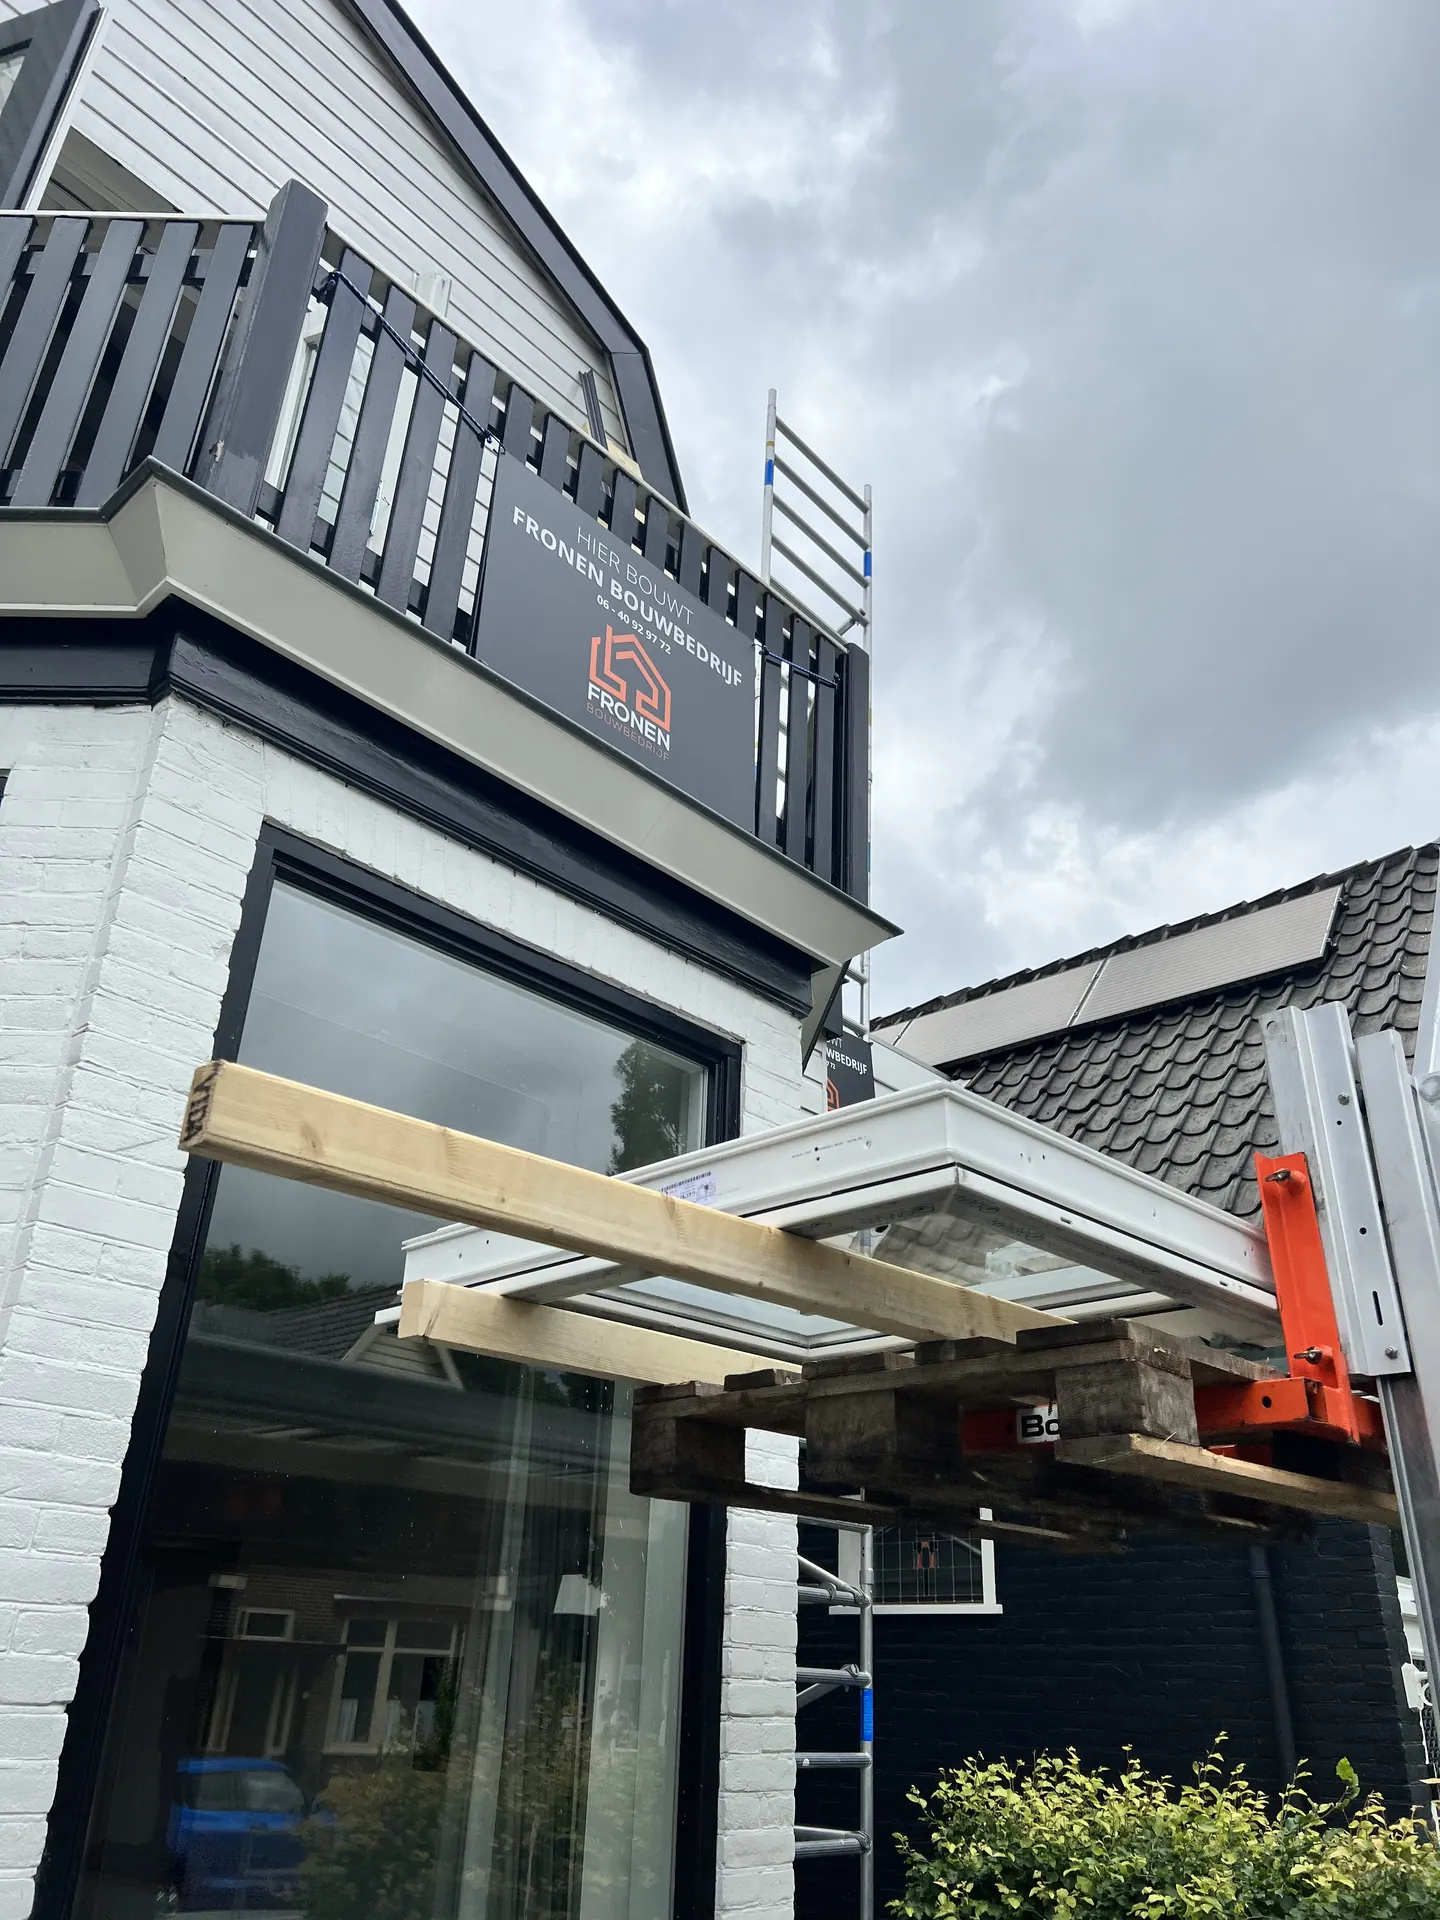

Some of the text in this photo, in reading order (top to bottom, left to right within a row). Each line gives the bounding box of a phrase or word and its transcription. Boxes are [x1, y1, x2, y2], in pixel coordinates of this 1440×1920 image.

[513, 506, 742, 687] FRONEN BOUWBEDRIJF
[577, 526, 694, 625] HIER BOUWT
[597, 595, 610, 609] 06
[617, 611, 630, 624] 40
[632, 620, 644, 635] 92
[645, 630, 658, 645] 97
[659, 641, 671, 655] 72
[587, 702, 669, 762] BOUWBEDRIJF
[588, 682, 670, 751] FRONEN
